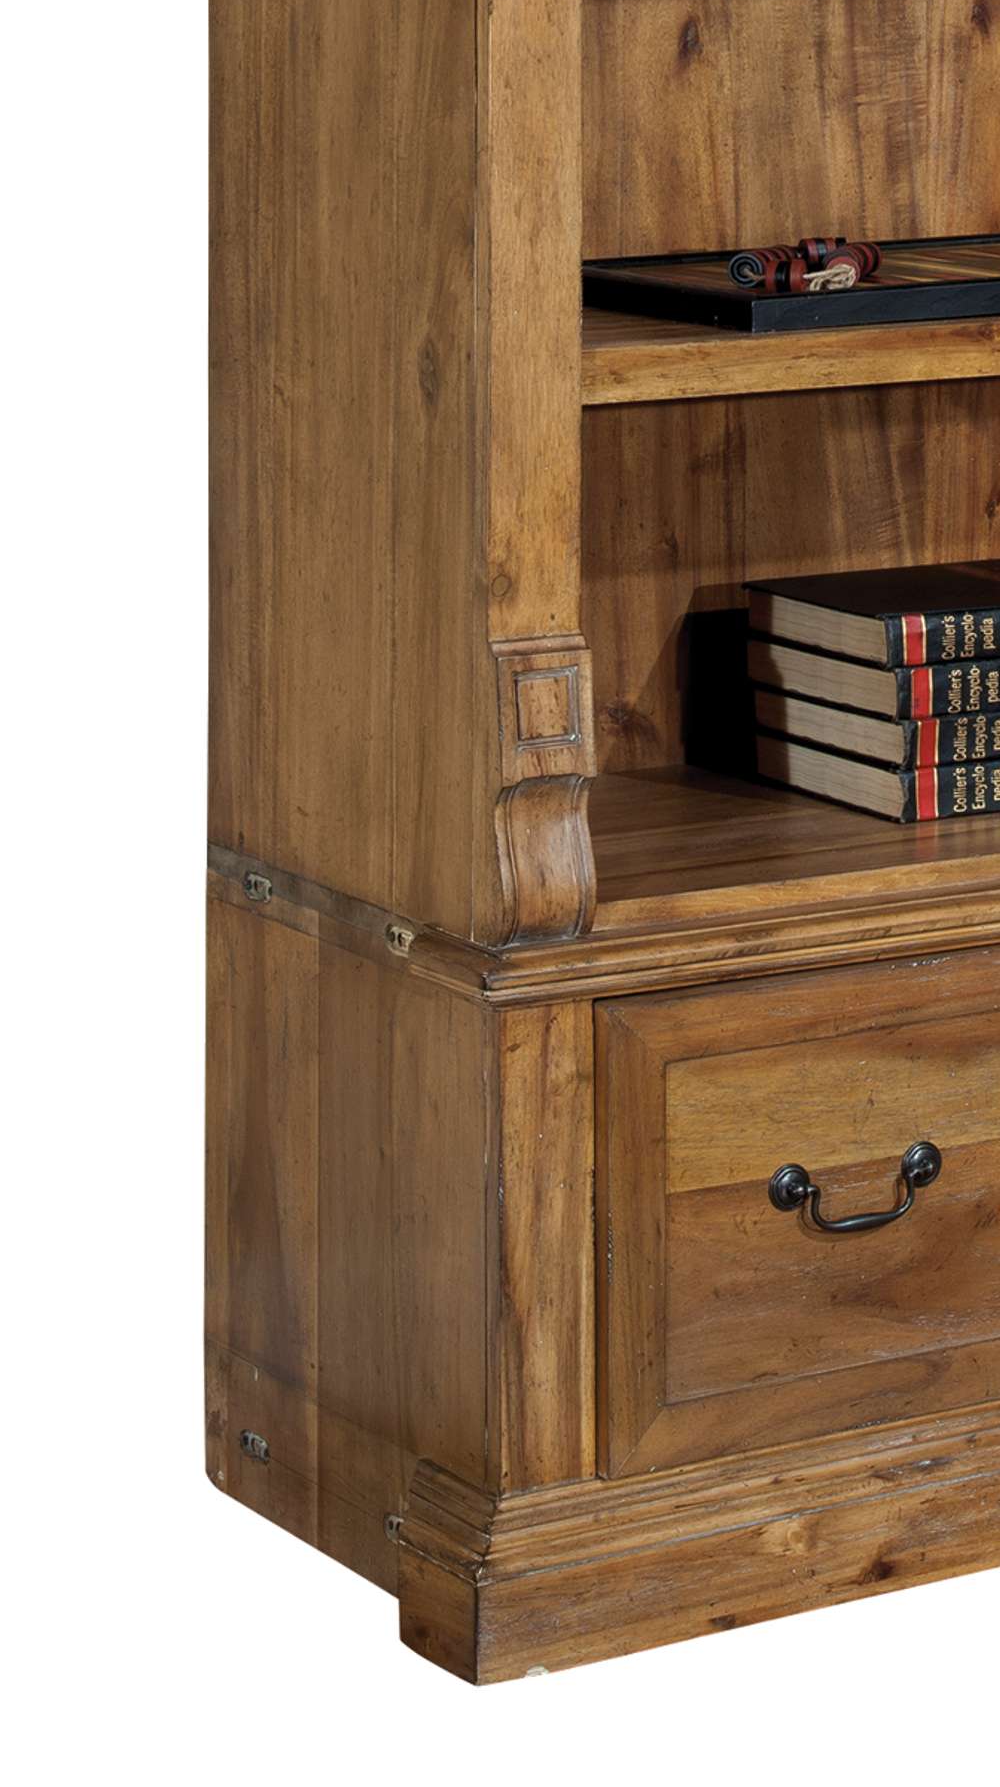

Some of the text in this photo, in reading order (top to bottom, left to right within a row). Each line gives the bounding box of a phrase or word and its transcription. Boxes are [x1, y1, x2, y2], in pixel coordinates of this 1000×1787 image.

[941, 615, 956, 660] Collier's
[979, 617, 996, 650] pedia
[947, 669, 962, 713] Collier's
[985, 670, 1000, 703] pedia
[953, 716, 968, 762] Collier's
[953, 767, 968, 812] Collier's
